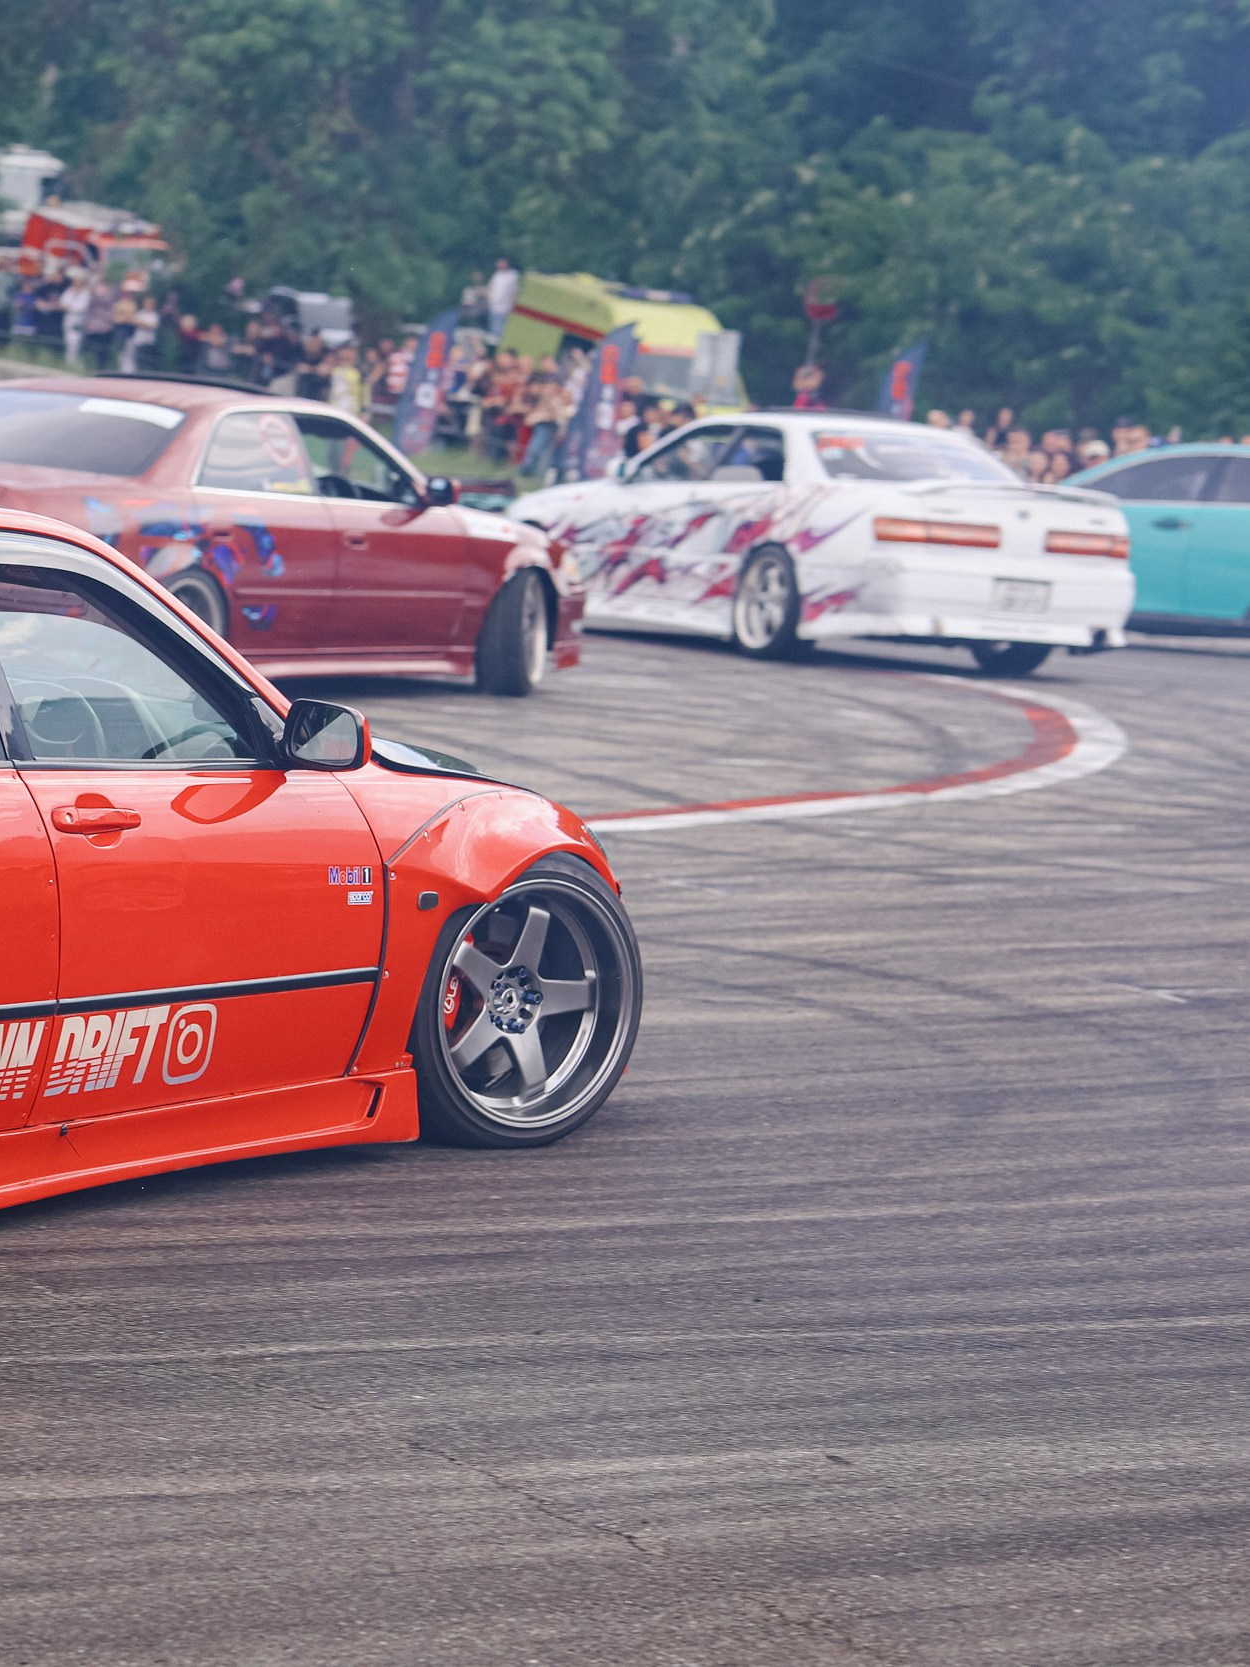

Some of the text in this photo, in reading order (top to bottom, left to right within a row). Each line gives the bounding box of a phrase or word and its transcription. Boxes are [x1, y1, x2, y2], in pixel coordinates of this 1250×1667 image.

[329, 866, 372, 885] Mobil 1
[43, 1005, 171, 1098] DRIFT
